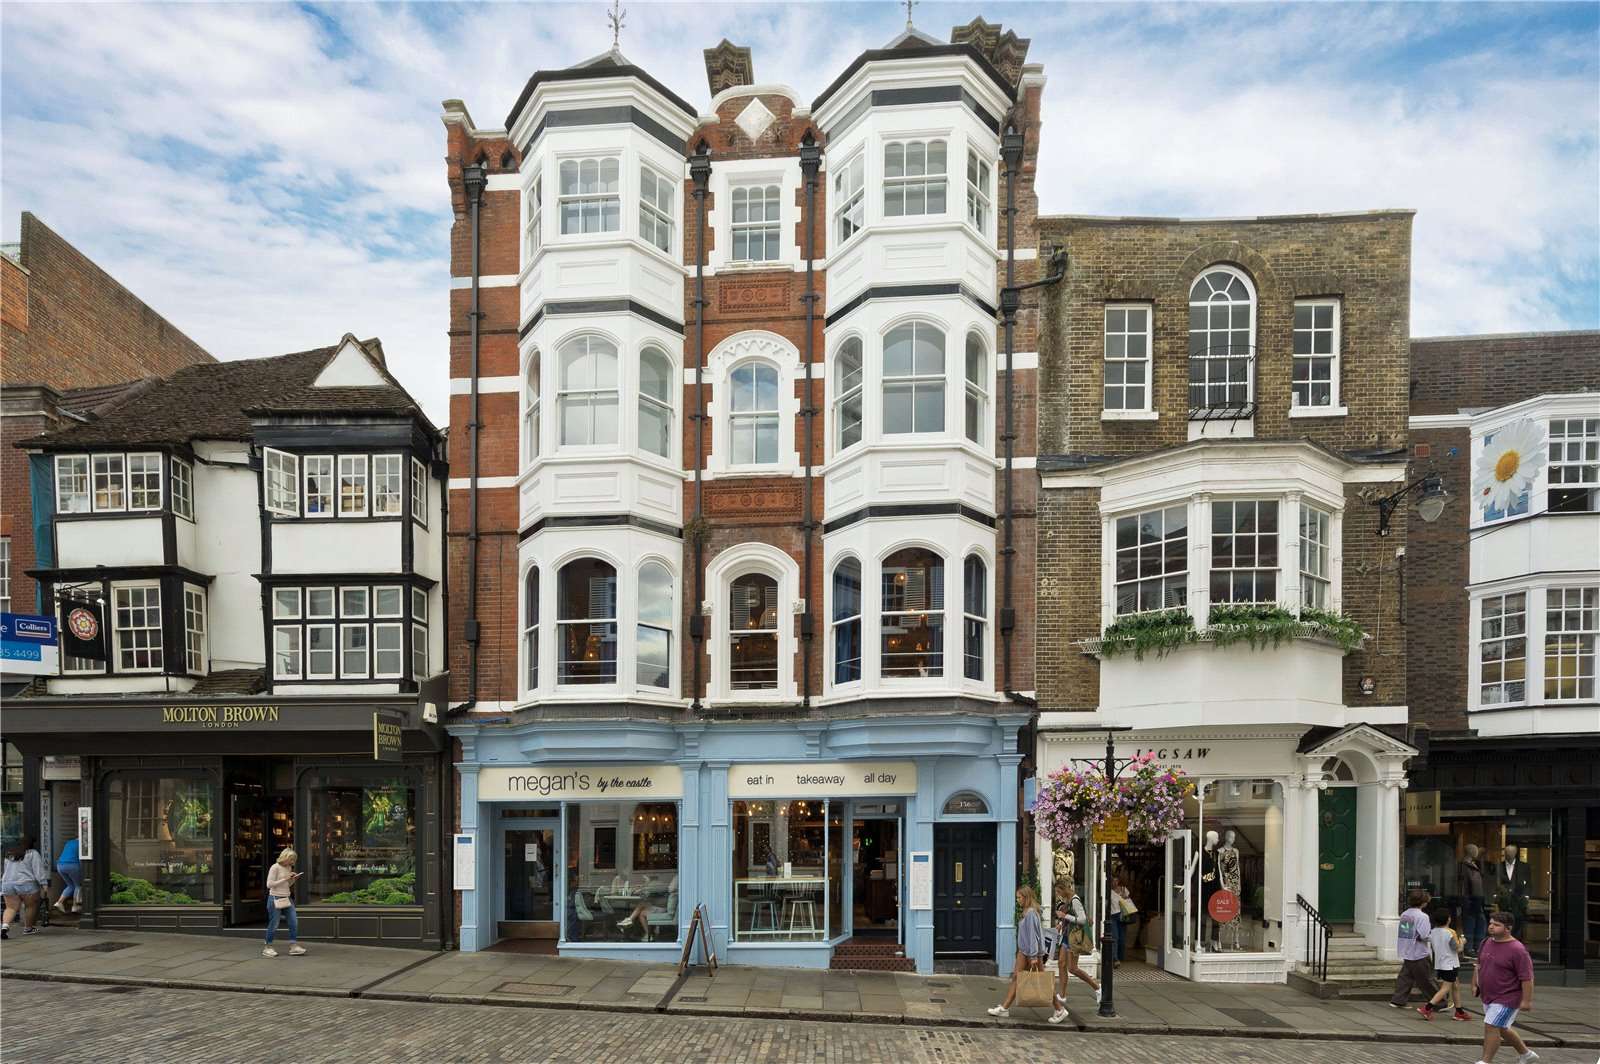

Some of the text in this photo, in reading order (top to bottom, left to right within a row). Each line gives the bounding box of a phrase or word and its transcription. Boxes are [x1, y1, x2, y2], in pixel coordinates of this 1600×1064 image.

[19, 622, 48, 632] Colliers
[162, 706, 279, 722] MOLTON BROWN
[377, 721, 401, 734] MOLTON
[378, 734, 402, 746] BROWN
[508, 771, 652, 795] megan's by the castle
[746, 774, 774, 785] eat in
[796, 774, 846, 786] takeaway
[863, 772, 897, 785] all day
